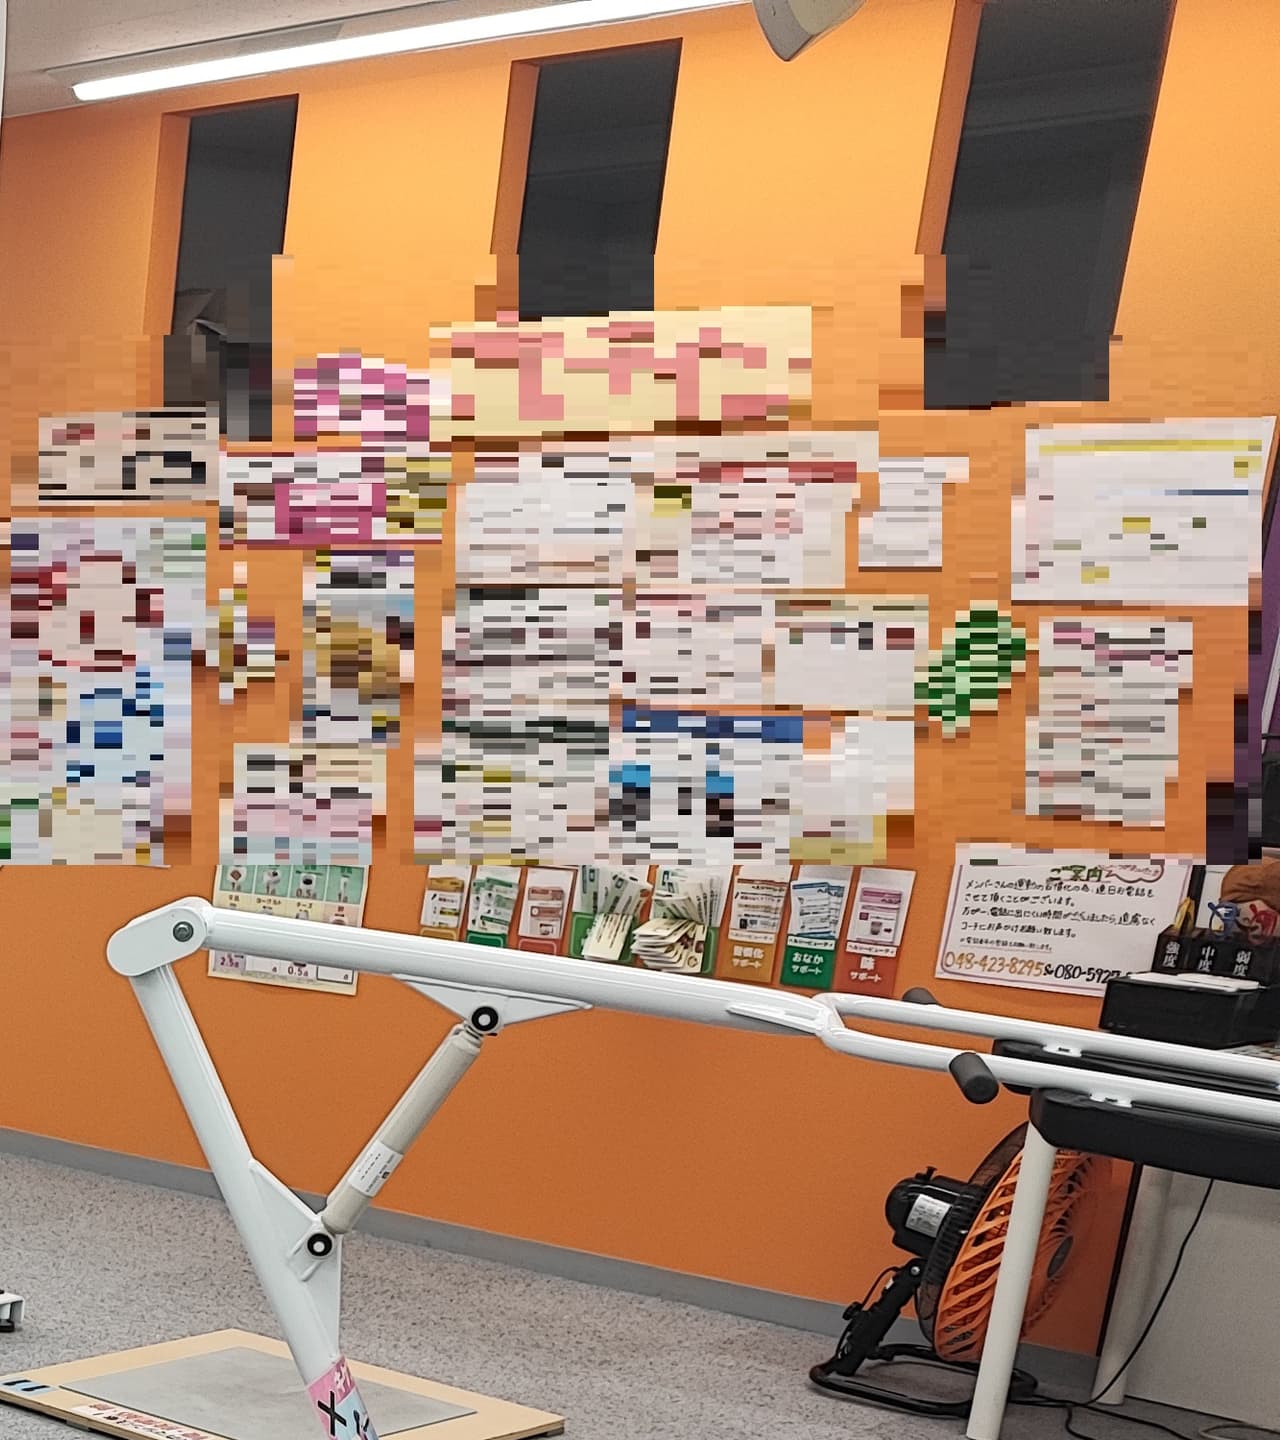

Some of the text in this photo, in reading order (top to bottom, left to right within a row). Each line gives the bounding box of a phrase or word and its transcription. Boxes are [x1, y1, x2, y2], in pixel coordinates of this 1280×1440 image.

[792, 952, 824, 964] おなか
[792, 965, 822, 975] サポート
[850, 971, 882, 982] サポート
